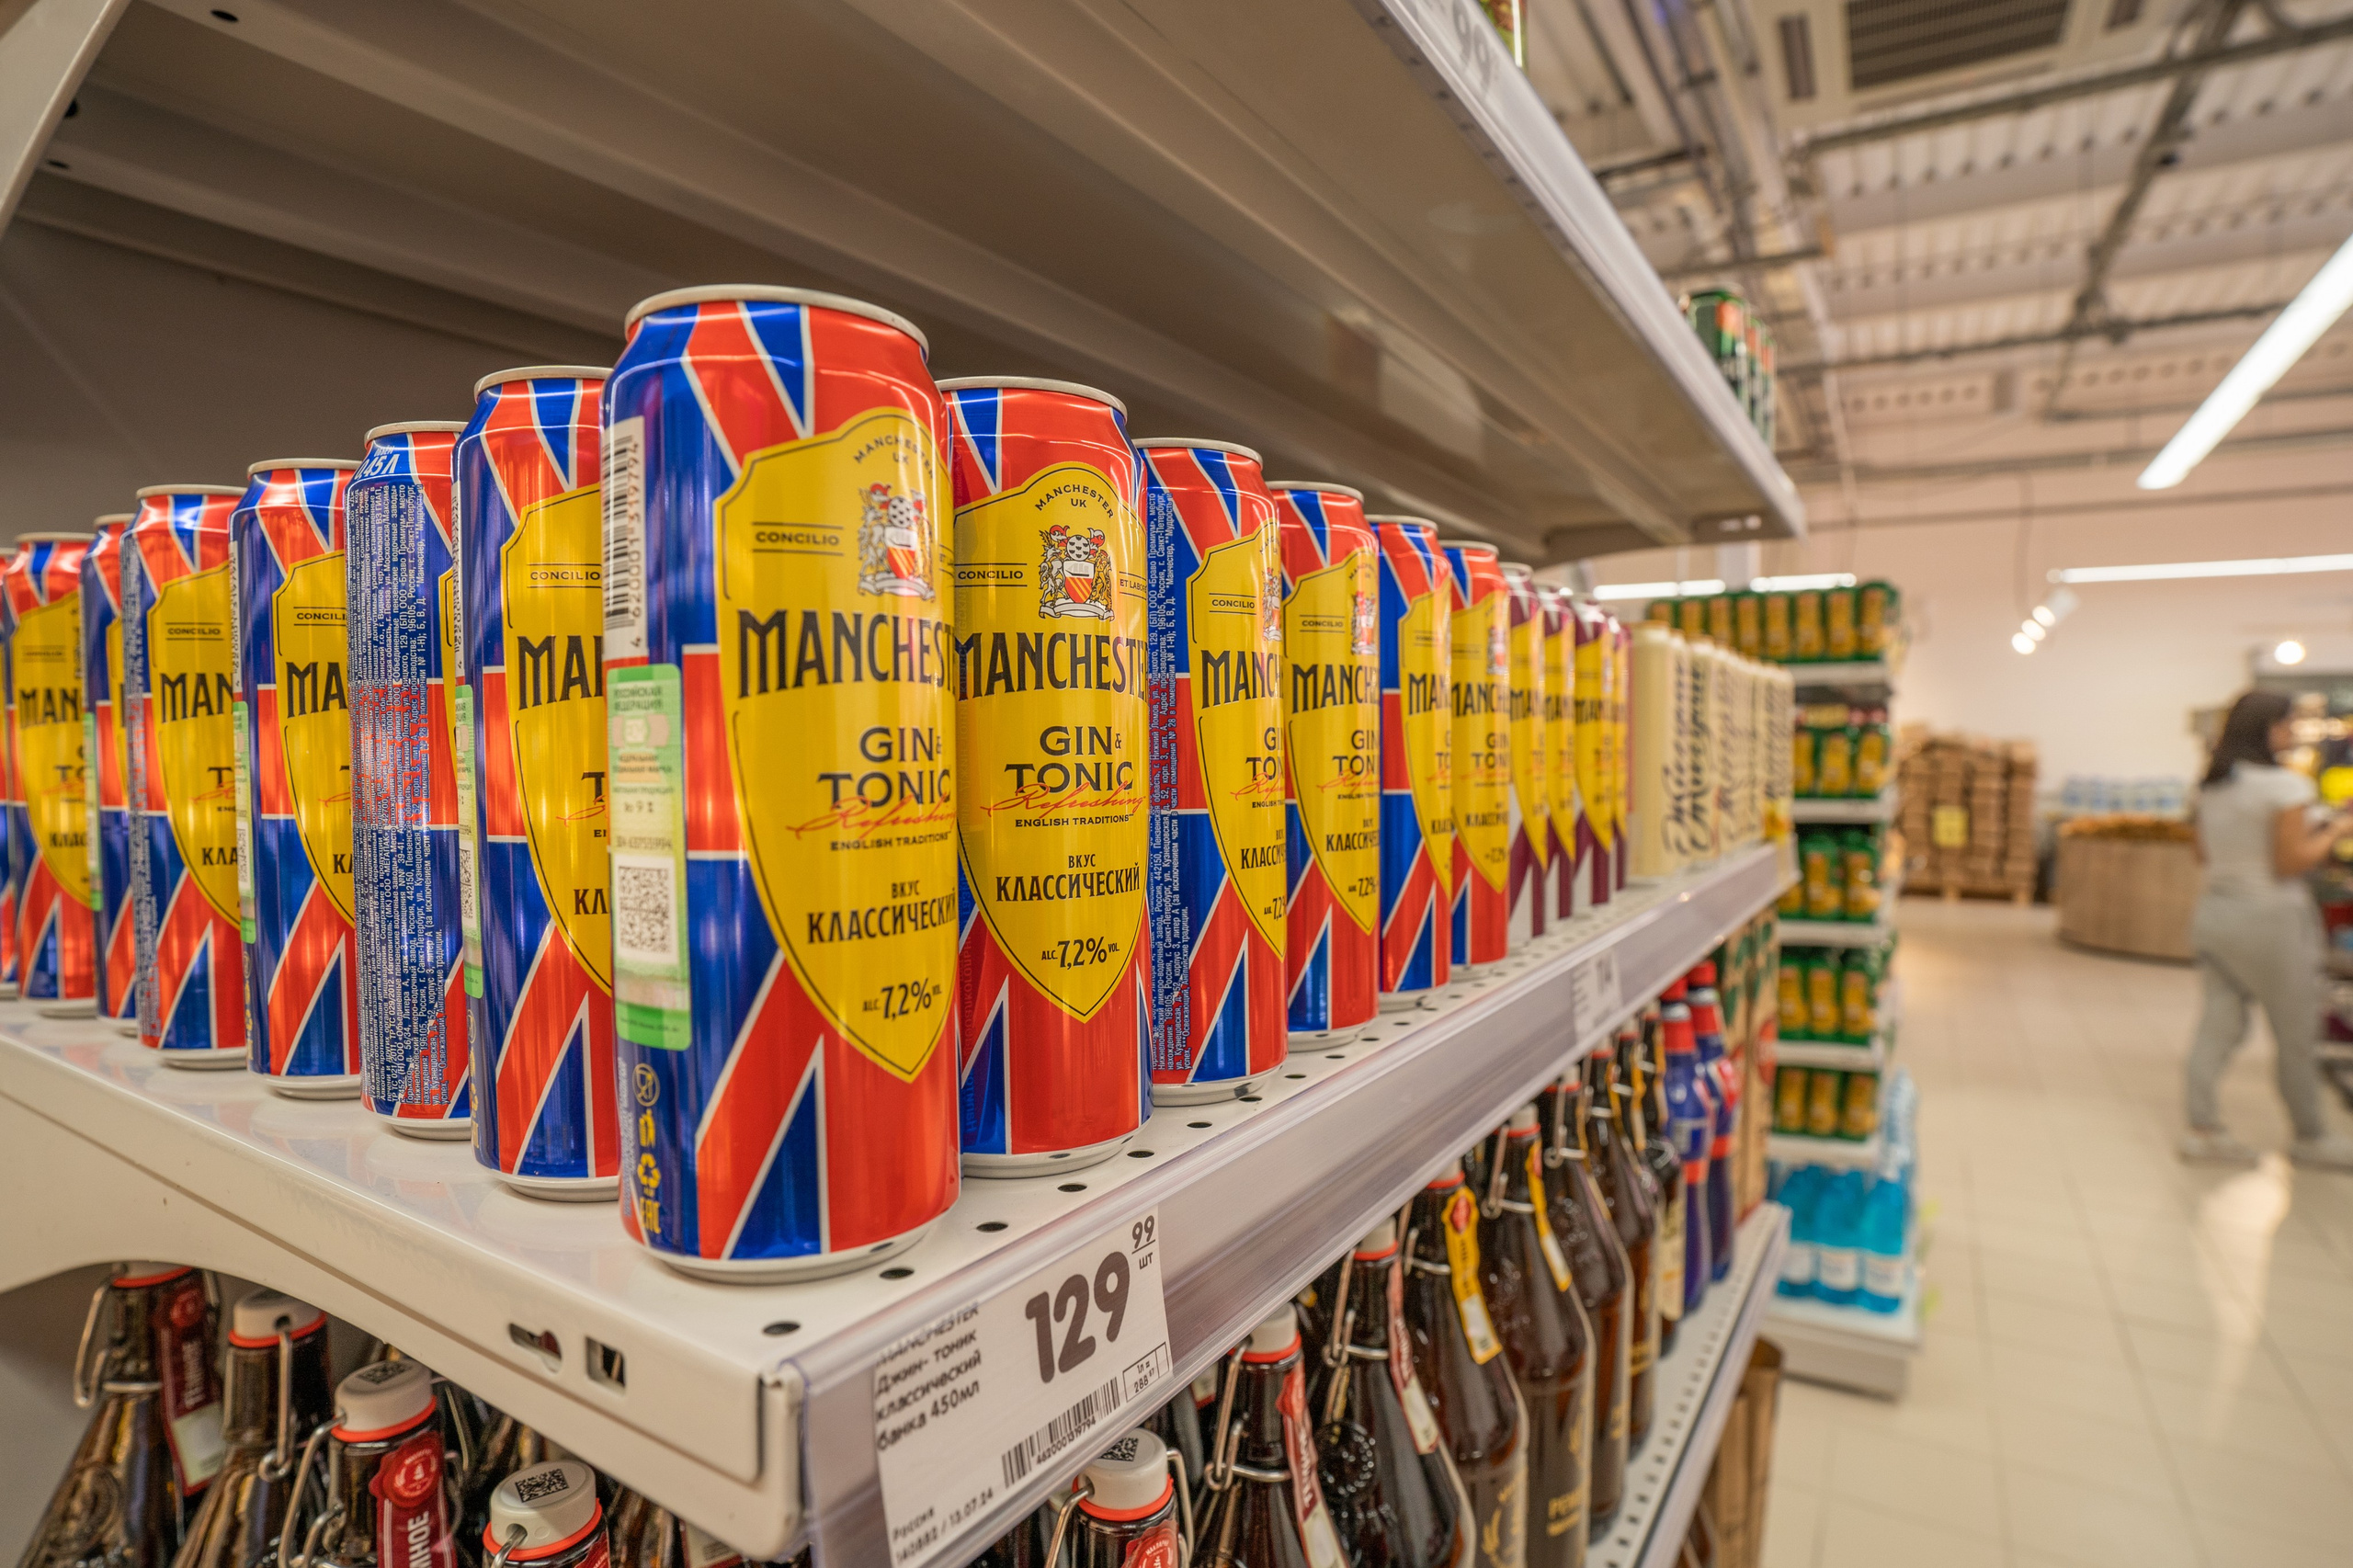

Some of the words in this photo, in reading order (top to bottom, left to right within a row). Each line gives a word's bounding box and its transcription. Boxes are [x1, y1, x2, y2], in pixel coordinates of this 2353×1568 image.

[1035, 483, 1114, 518] MANCHESTER
[1070, 498, 1087, 508] UK
[755, 530, 840, 547] CONCILIO
[1149, 519, 1158, 558] Премиум»,
[1157, 494, 1165, 557] Санкт-Петербург,
[529, 571, 600, 581] CONCILIO
[958, 570, 1024, 580] CONCILIO
[1120, 579, 1129, 587] ET
[1149, 562, 1158, 587] «Браво
[1158, 570, 1166, 597] Россия,
[1149, 590, 1157, 608] ООО
[1211, 599, 1256, 609] CONCILIO
[1150, 611, 1158, 627] (БП)
[1158, 602, 1166, 630] 196105,
[737, 608, 956, 699] MANCHEST
[1151, 650, 1159, 685] Урицкого,
[1159, 635, 1167, 688] производства:
[1167, 665, 1176, 707] помещении
[1151, 702, 1159, 728] Ломов,
[1159, 693, 1168, 715] Адрес
[1168, 719, 1176, 727] 28
[859, 726, 934, 764] GIN
[1040, 726, 1113, 756] GIN
[1114, 733, 1121, 749] &
[1152, 732, 1160, 760] Нижний
[1004, 761, 1134, 794] TONIC
[1169, 744, 1177, 784] помещения
[817, 768, 951, 809] TONIC
[980, 781, 1146, 818] Refreshing
[1153, 771, 1161, 802] область,
[1161, 788, 1169, 799] 52,
[1015, 818, 1070, 827] ENGLISH
[830, 840, 893, 851] ENGLISH
[1163, 814, 1171, 867] Кузнецовская,
[1068, 853, 1096, 869] ВКУС
[1154, 851, 1163, 881] 442150,
[1171, 843, 1179, 891] исключением
[892, 881, 919, 899] ВКУС
[996, 862, 1140, 902] КЛАССИЧЕСКИЙ
[1155, 884, 1164, 912] Россия,
[807, 887, 957, 944] КЛАССИЧЕСКИЙ
[1171, 895, 1181, 905] (за
[1155, 915, 1164, 938] завод,
[1164, 885, 1172, 948] Санкт-Петербург,
[1173, 918, 1181, 937] литер
[1181, 907, 1189, 942] традиции.
[436, 929, 444, 967] традиции.
[1057, 937, 1107, 971] 7,2%
[1173, 952, 1181, 976] корпус
[1156, 941, 1165, 1005] ликеро-водочный
[1165, 960, 1173, 988] Россия,
[1181, 945, 1189, 984] Английские
[437, 970, 445, 1013] Английские
[881, 978, 932, 1020] 7,2%
[1173, 980, 1182, 991] 52,
[395, 979, 404, 1040] «Объединенные
[1165, 994, 1174, 1020] 196105,
[1157, 1008, 1165, 1070] Нижнеломовский
[1174, 1006, 1183, 1055] Кузнецовская,
[1184, 1048, 1192, 1070] успех,
[440, 1081, 449, 1104] успех,
[1132, 1215, 1155, 1250] 99
[1026, 1252, 1131, 1384] 129
[934, 1329, 976, 1362] тоник
[876, 1349, 982, 1423] классический
[1134, 1377, 1149, 1393] 288
[877, 1413, 926, 1450] банка
[931, 1381, 980, 1418] 450мл
[1037, 1415, 1096, 1464] 4620001319794
[892, 1506, 934, 1542] Россия
